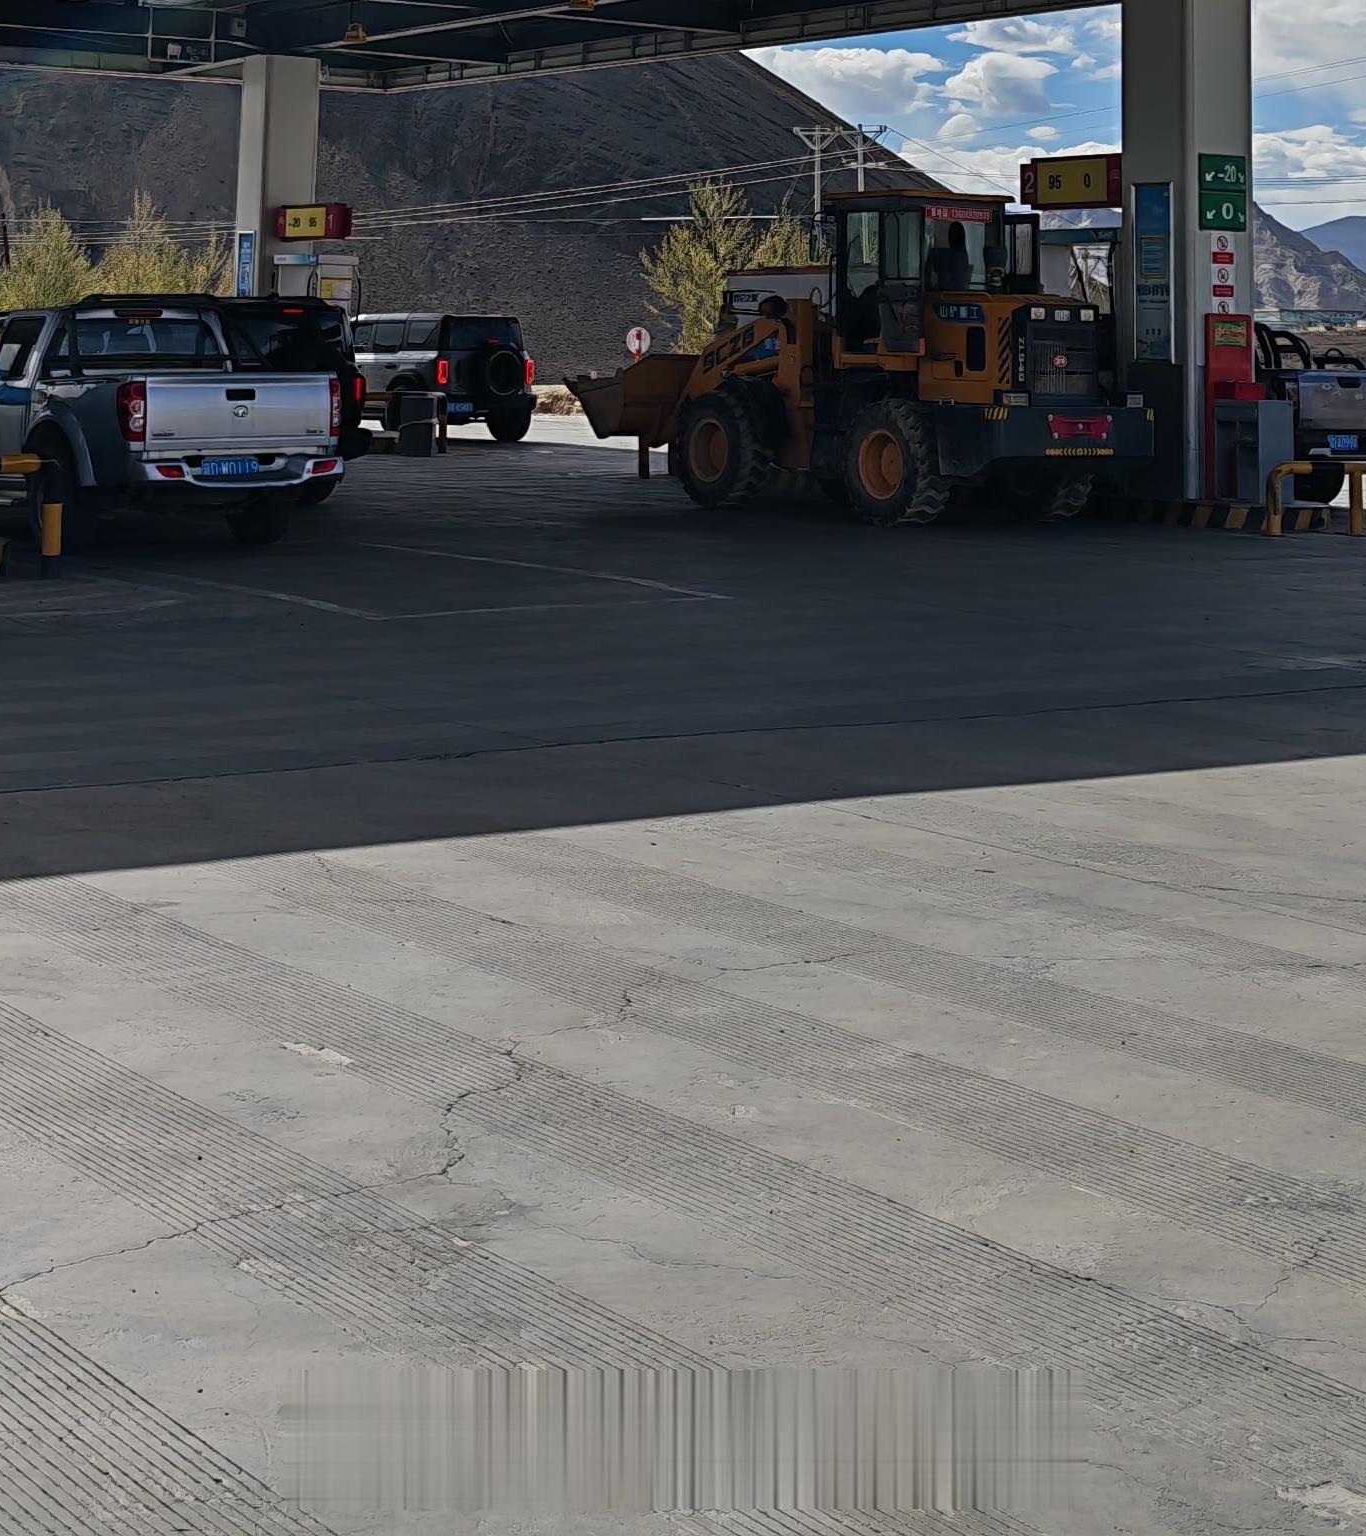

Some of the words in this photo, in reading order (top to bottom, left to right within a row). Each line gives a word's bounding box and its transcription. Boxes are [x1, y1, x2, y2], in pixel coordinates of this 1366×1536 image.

[1024, 171, 1035, 193] 2
[1048, 174, 1062, 190] 95
[1083, 172, 1092, 188] 0
[1217, 165, 1237, 183] -20
[1221, 202, 1234, 220] 0
